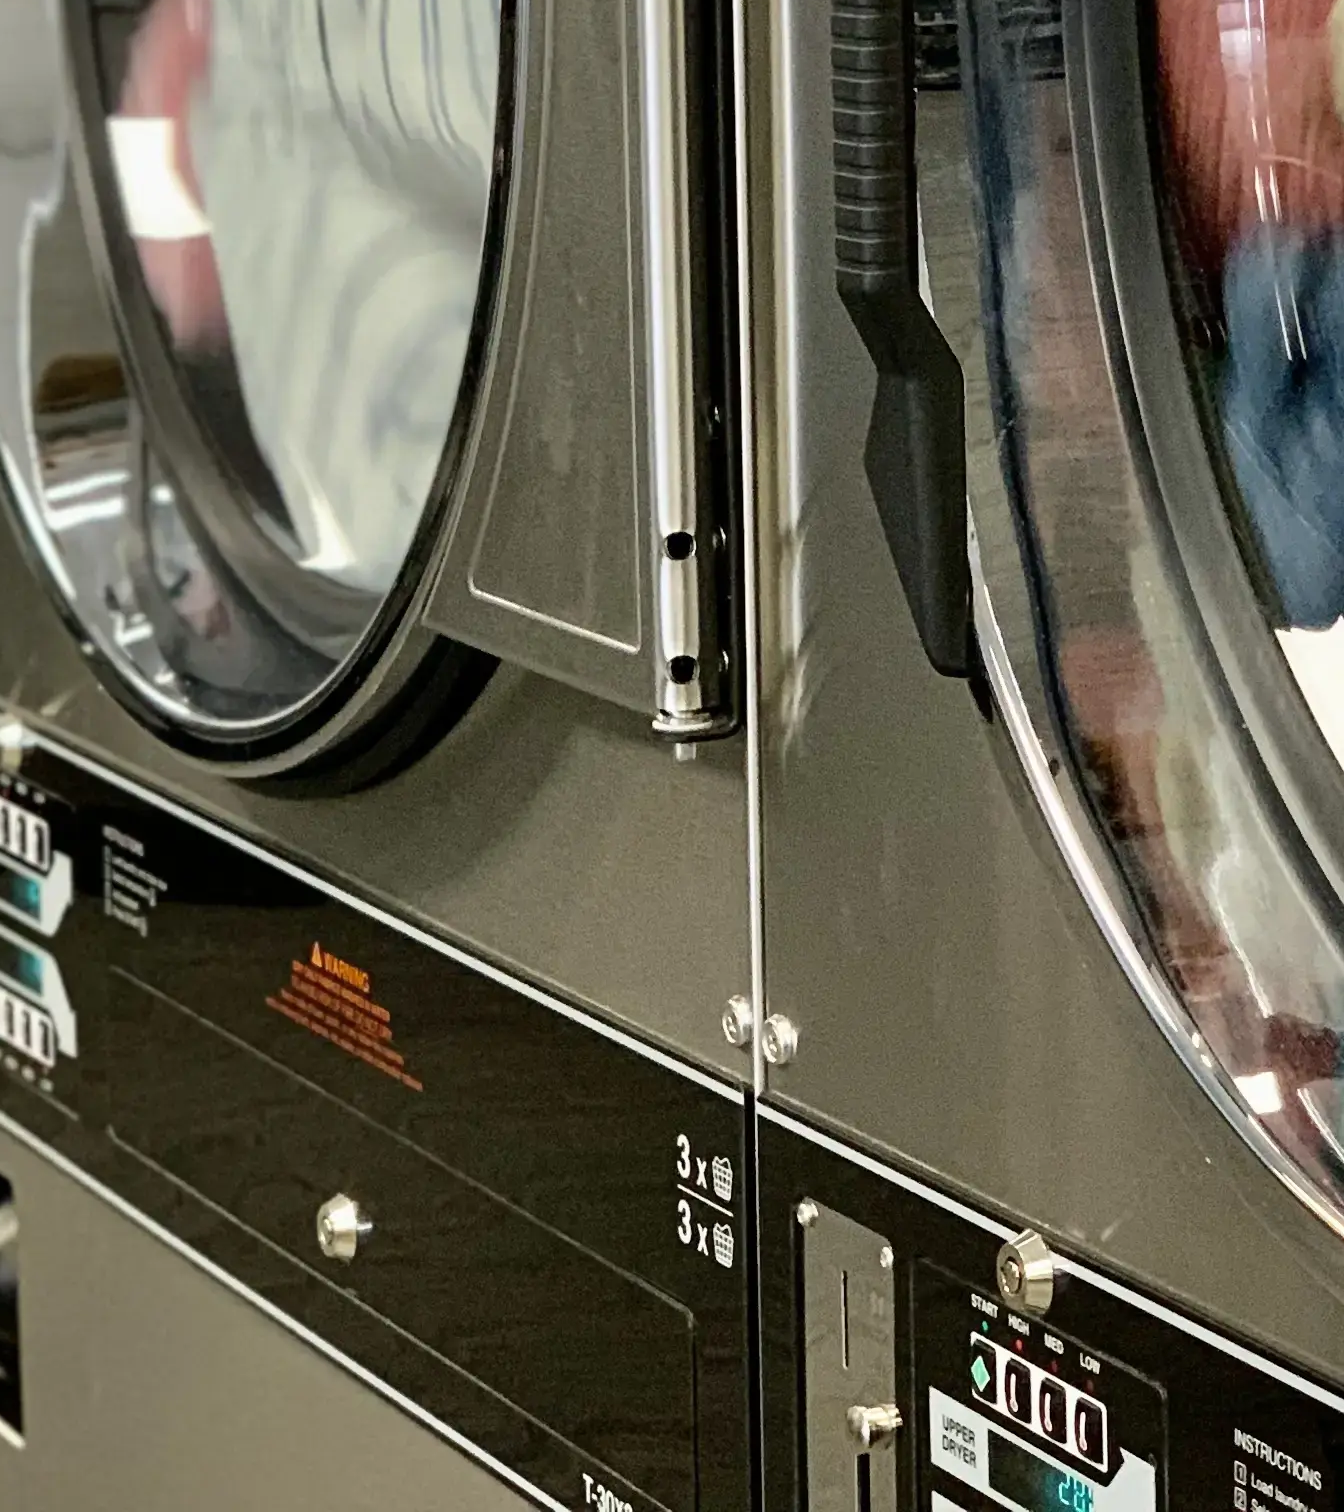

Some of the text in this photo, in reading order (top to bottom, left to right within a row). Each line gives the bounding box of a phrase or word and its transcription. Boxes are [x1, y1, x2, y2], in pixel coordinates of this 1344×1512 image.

[676, 1133, 707, 1190] 3 x
[677, 1199, 709, 1256] 3 x
[970, 1292, 1101, 1375] START HIGH MED LOW
[941, 1413, 976, 1448] UPPER
[941, 1434, 977, 1469] DRYER
[1234, 1428, 1322, 1491] INSTRUCTIONS
[1250, 1472, 1274, 1498] Load
